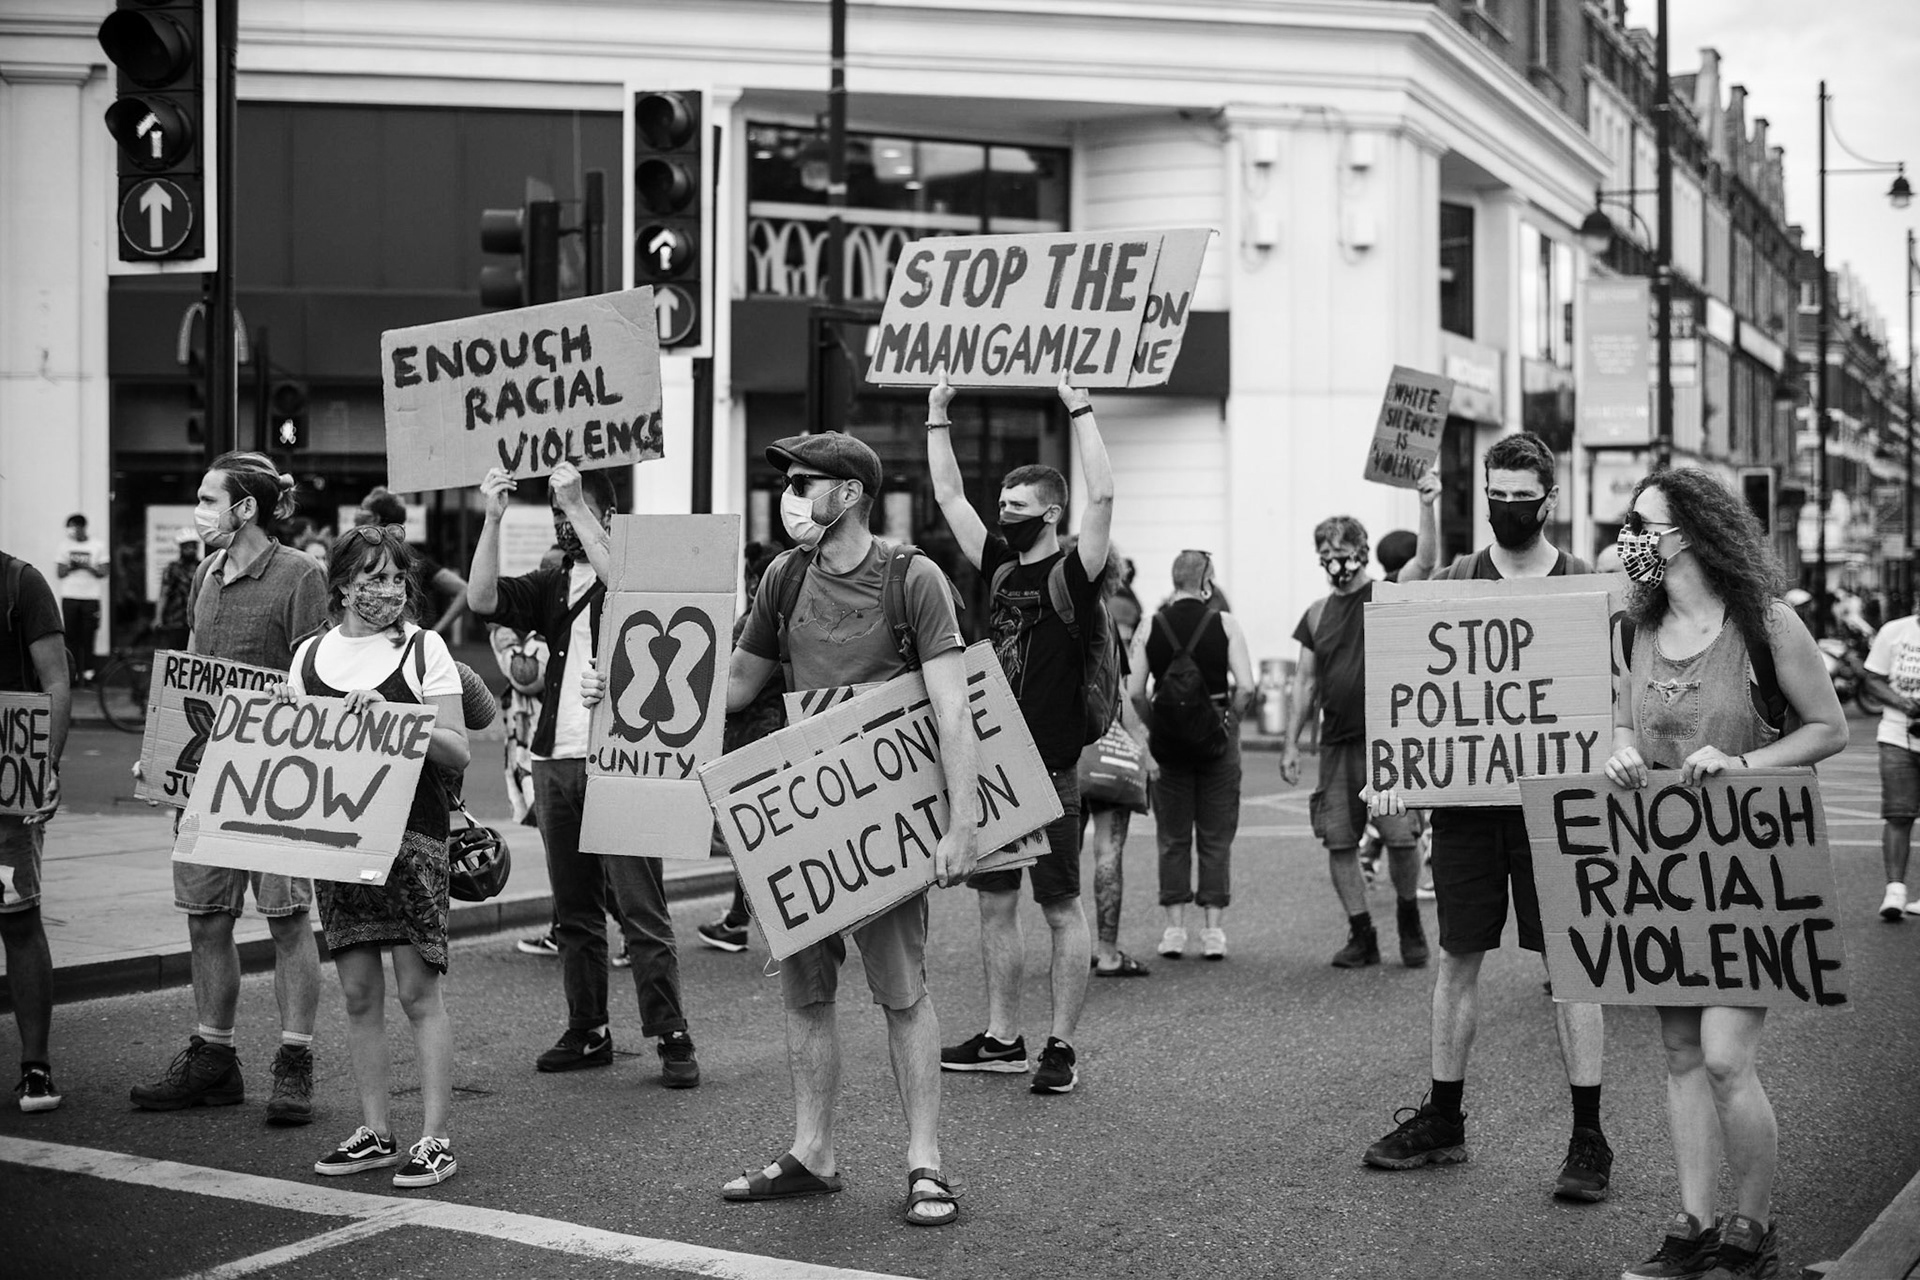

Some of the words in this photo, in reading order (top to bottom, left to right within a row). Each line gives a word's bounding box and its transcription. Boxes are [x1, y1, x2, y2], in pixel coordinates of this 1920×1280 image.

[899, 246, 1028, 309] STOP
[1044, 241, 1148, 312] THE
[874, 322, 1121, 376] MAANGAMIZI
[464, 366, 623, 430] RACIAL
[1384, 408, 1438, 438] SILENCE
[1394, 383, 1440, 413] WHITE
[1395, 432, 1409, 450] IS
[1426, 618, 1534, 675] STOP
[211, 694, 435, 760] DECOLONISE
[1391, 678, 1558, 728] POLICE
[210, 755, 392, 822] NOW
[1371, 730, 1599, 792] BRUTALITY
[1552, 784, 1815, 855] ENOUGH
[1575, 851, 1823, 918] RACIAL
[1567, 917, 1847, 1007] VIOLENCE
